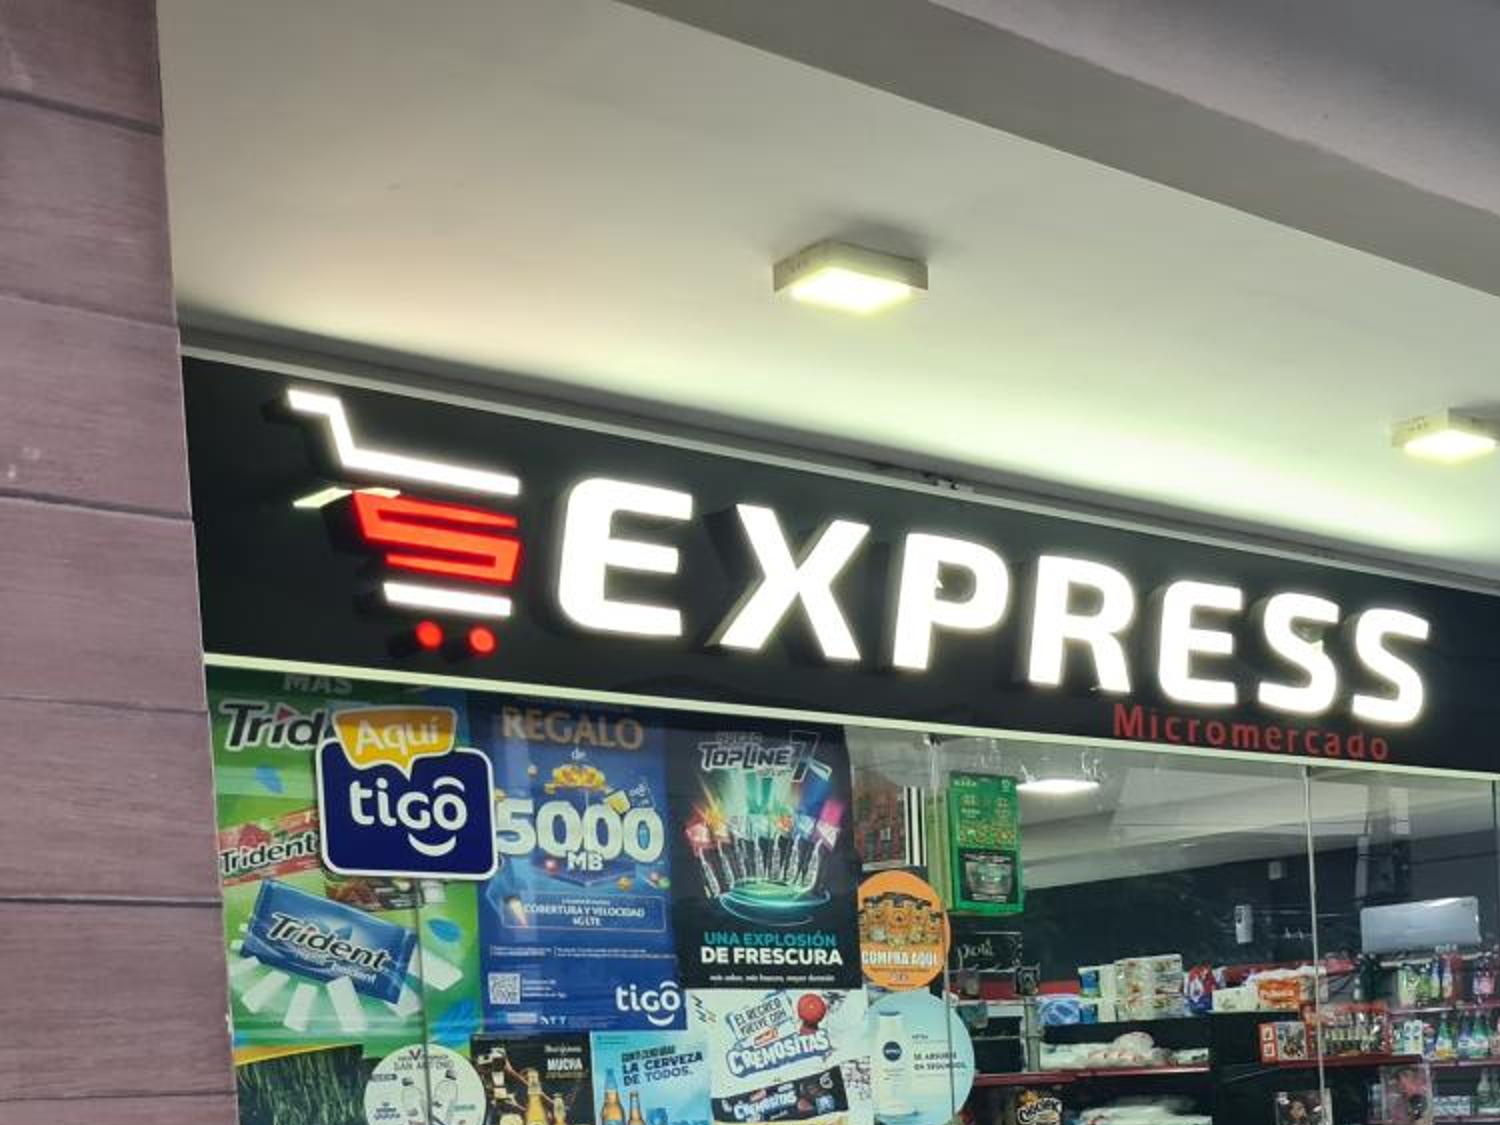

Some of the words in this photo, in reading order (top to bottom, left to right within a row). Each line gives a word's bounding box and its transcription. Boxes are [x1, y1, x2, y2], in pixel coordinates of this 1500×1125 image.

[557, 476, 1431, 726] EXPRESS
[222, 702, 325, 751] Trid
[354, 714, 441, 756] Aquí
[501, 704, 644, 750] REGALO
[1112, 703, 1390, 762] Micromercado
[349, 776, 468, 831] tigo
[220, 830, 319, 874] Trident
[495, 797, 665, 862] 5000
[567, 850, 604, 872] MB
[267, 911, 390, 972] Trident
[701, 946, 730, 964] DE
[733, 947, 844, 965] FRESCURA
[704, 931, 740, 945] UNA
[743, 930, 837, 947] EXPLOSIÓN
[615, 980, 681, 1012] tigo
[623, 1061, 639, 1075] LA
[644, 1051, 703, 1071] CERVEZA
[728, 1029, 829, 1075] CREMOSITAS
[623, 1073, 641, 1087] DE
